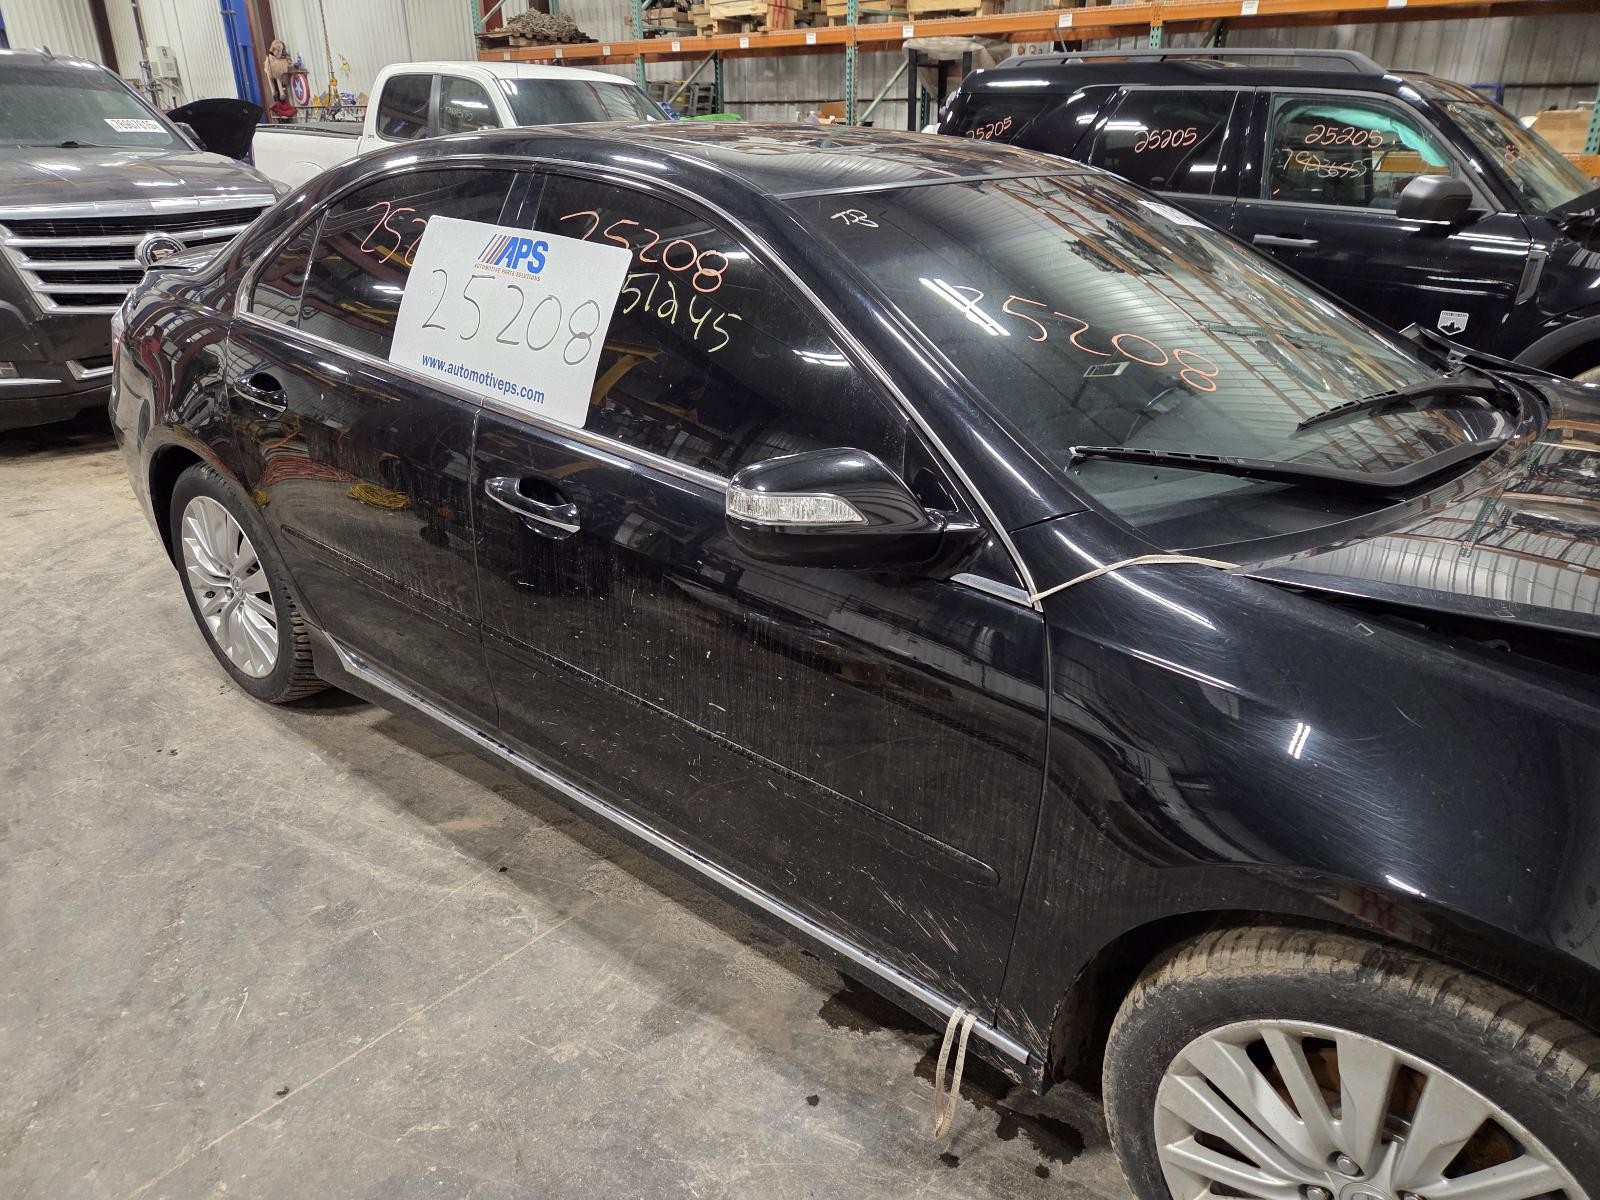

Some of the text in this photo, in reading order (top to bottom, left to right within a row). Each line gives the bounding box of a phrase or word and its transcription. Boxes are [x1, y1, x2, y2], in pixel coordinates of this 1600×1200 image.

[1134, 127, 1197, 154] 25205
[1304, 124, 1383, 149] 25205
[495, 235, 549, 274] APS
[474, 263, 541, 282] AUTOMOTIVE PARTS SOLUTIONS
[421, 268, 601, 366] 25208
[421, 353, 546, 405] www.automotiveps.com
